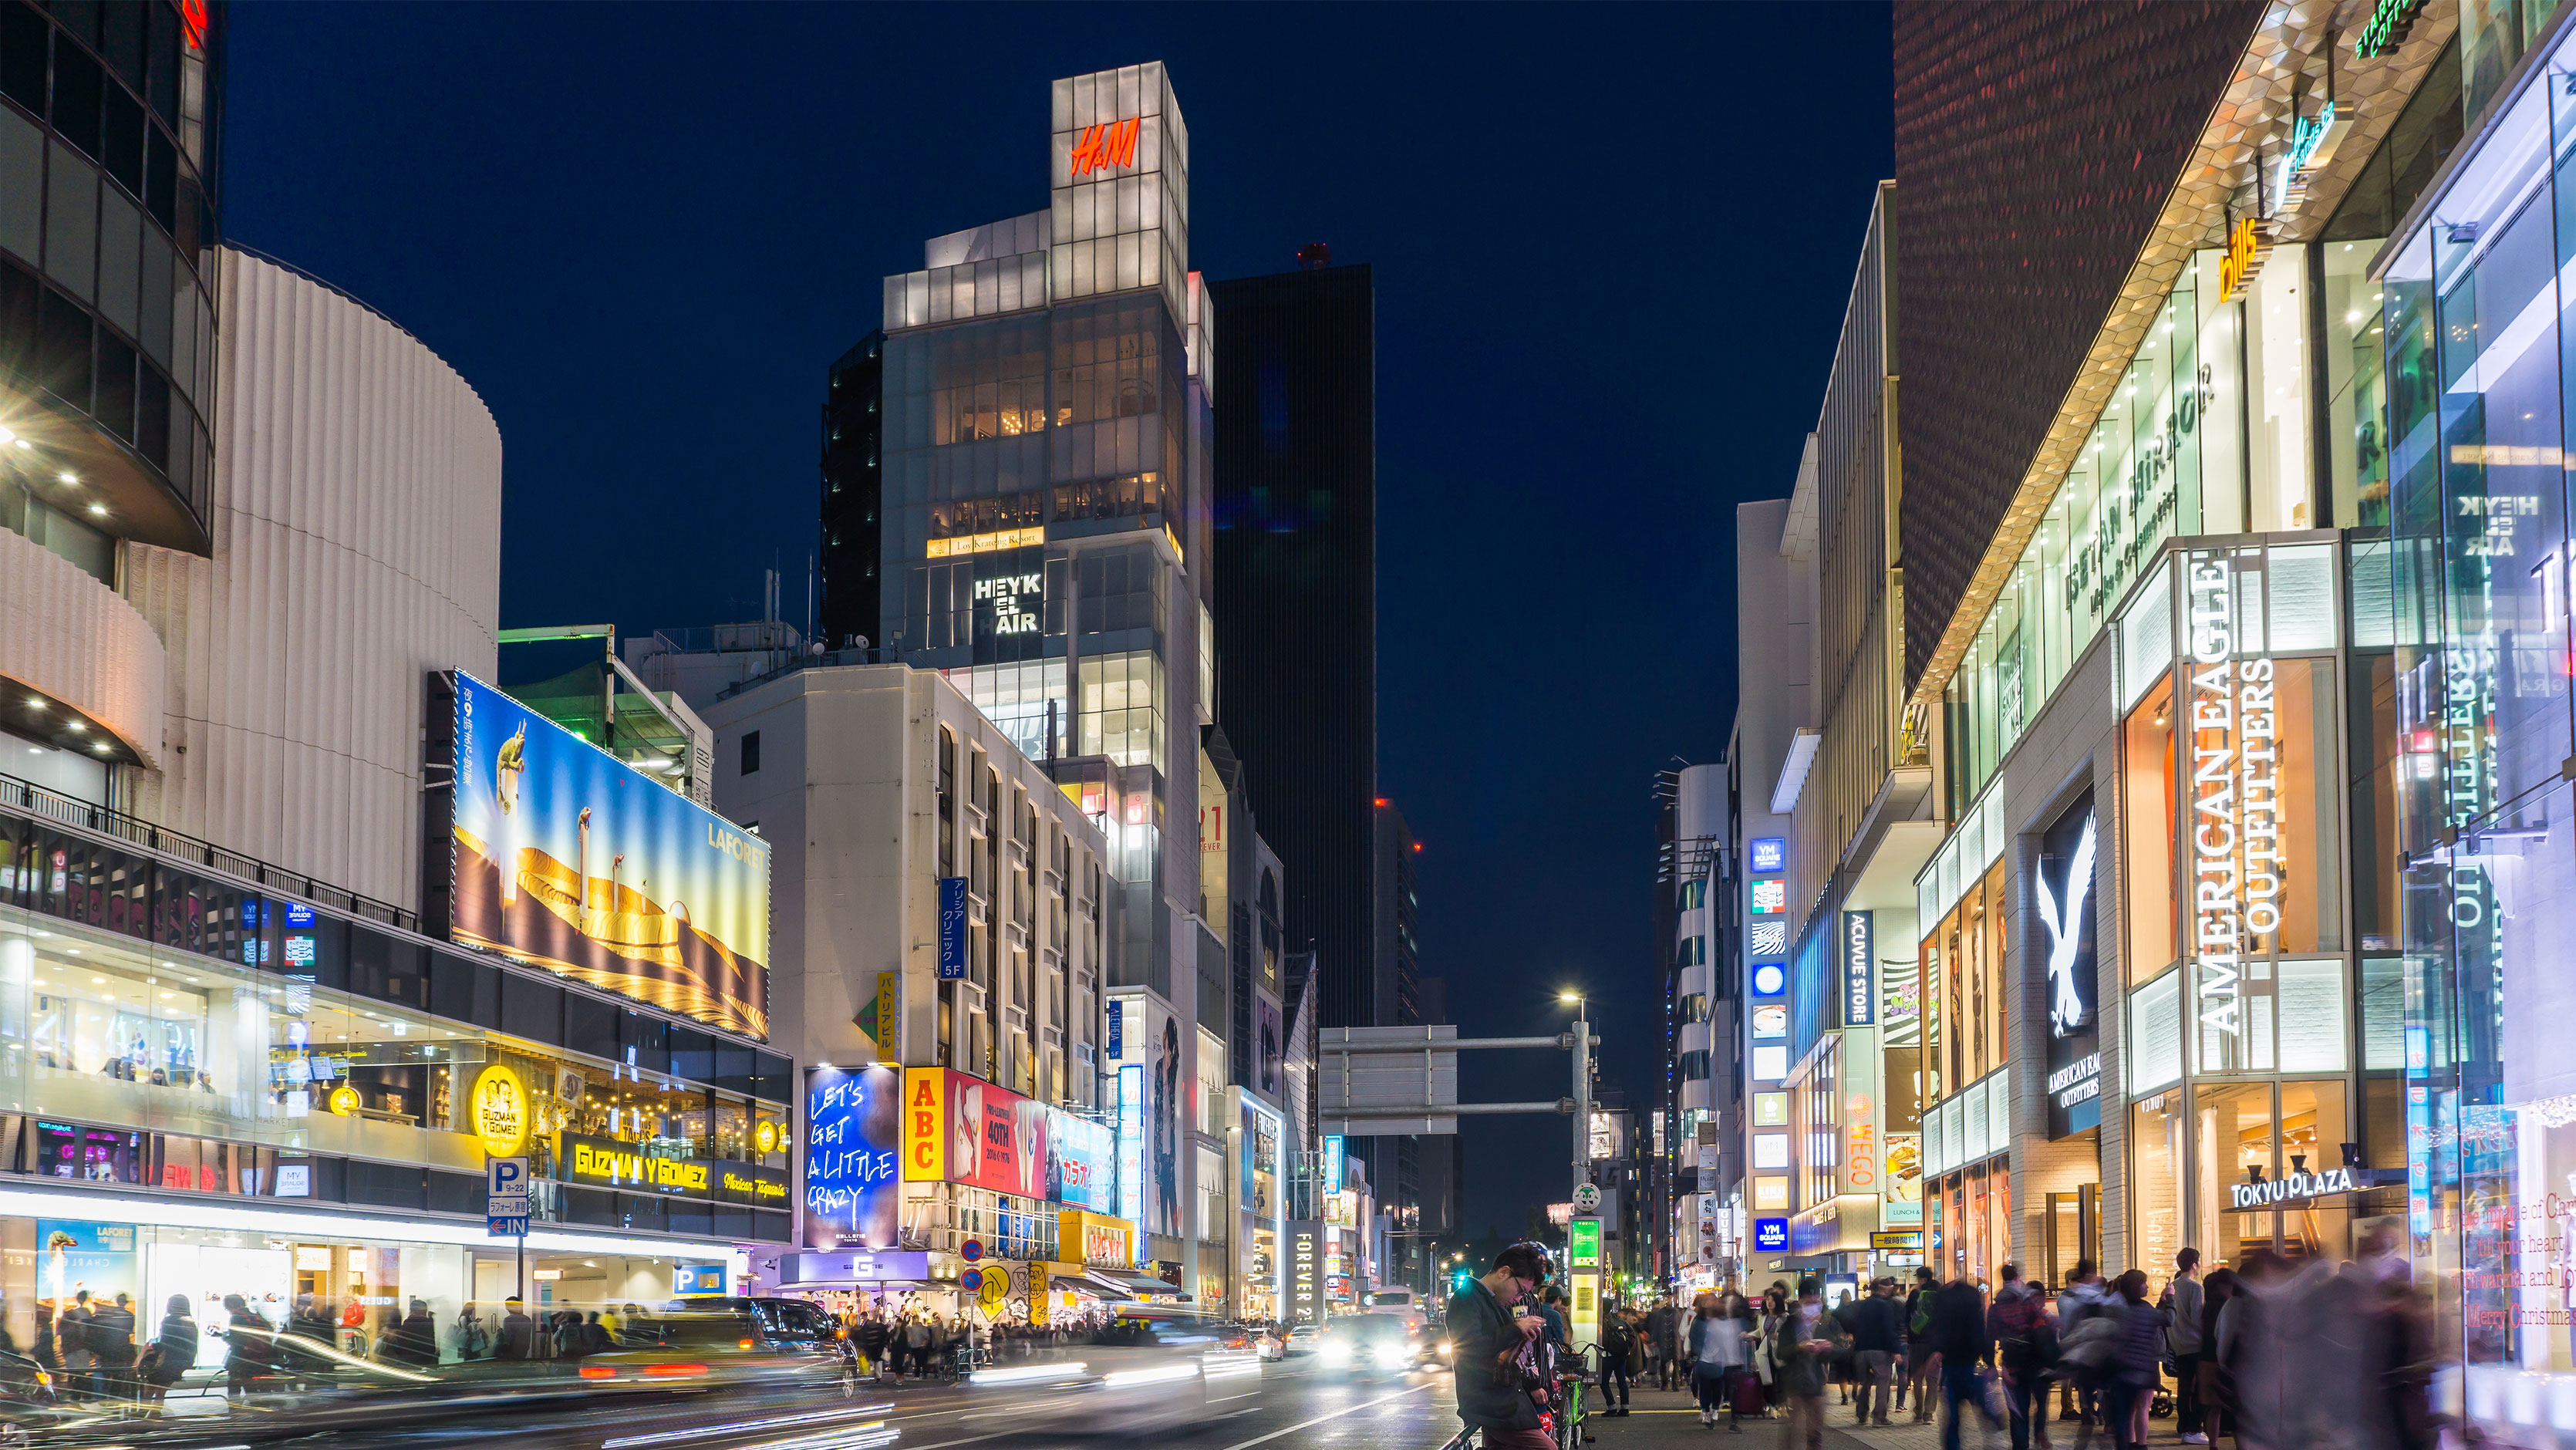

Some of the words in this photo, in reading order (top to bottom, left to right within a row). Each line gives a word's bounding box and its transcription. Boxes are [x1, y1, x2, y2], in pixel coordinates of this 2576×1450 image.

[1071, 116, 1139, 175] H&M
[2220, 218, 2256, 303] bills
[957, 541, 972, 551] Loy
[975, 536, 1007, 548] Kratong
[1009, 534, 1035, 544] Resort
[994, 596, 1020, 615] EL
[2190, 559, 2233, 733] EAGLE
[696, 747, 709, 789] GOLF
[2241, 657, 2281, 934] OUTFITTERS
[708, 822, 766, 871] LAFORET
[1759, 845, 1775, 855] YM
[955, 880, 963, 920] アリシア
[2193, 748, 2240, 1037] AMERICAN
[942, 911, 953, 961] クリニック
[1852, 914, 1866, 976] ACUVUE
[945, 966, 961, 976] 5F
[881, 977, 892, 1048] パトリアビル
[1852, 977, 1866, 1023] STORE
[2048, 1059, 2087, 1094] AMERICAN
[2061, 1077, 2099, 1108] OUTFITTERS
[483, 1108, 516, 1123] GUZMAN
[811, 1080, 863, 1120] LET'S
[255, 1114, 292, 1128] MARKET
[483, 1121, 490, 1131] Y
[490, 1121, 518, 1135] GOMEZ
[811, 1116, 850, 1146] GET
[913, 1080, 936, 1168] ABC
[987, 1121, 1009, 1148] 40TH
[808, 1157, 821, 1179] A
[824, 1149, 895, 1182] LITTLE
[1850, 1124, 1874, 1185] WEGO
[495, 1162, 520, 1192] P
[506, 1184, 524, 1192] 9-22
[645, 1158, 656, 1183] Y
[658, 1157, 707, 1189] GOMEZ
[723, 1173, 754, 1192] Mexican
[754, 1179, 786, 1198] Taqueria
[2230, 1179, 2284, 1208] TOKYU
[2288, 1168, 2352, 1199] PLAZA
[490, 1202, 526, 1214] ラフォーレ原宿
[808, 1185, 864, 1230] CRAZY
[2432, 1208, 2458, 1232] May
[2530, 1199, 2544, 1219] of
[96, 1227, 133, 1237] LAFORET
[507, 1219, 526, 1233] IN
[1764, 1225, 1780, 1234] YM
[2477, 1238, 2495, 1257] fill
[2496, 1239, 2525, 1260] your
[2527, 1234, 2565, 1253] heart
[677, 1270, 694, 1291] P
[1296, 1233, 1313, 1301] FOREVER
[2451, 1271, 2477, 1290] wth
[2480, 1268, 2527, 1289] warmth
[2529, 1266, 2554, 1286] and
[2465, 1304, 2506, 1330] Merry
